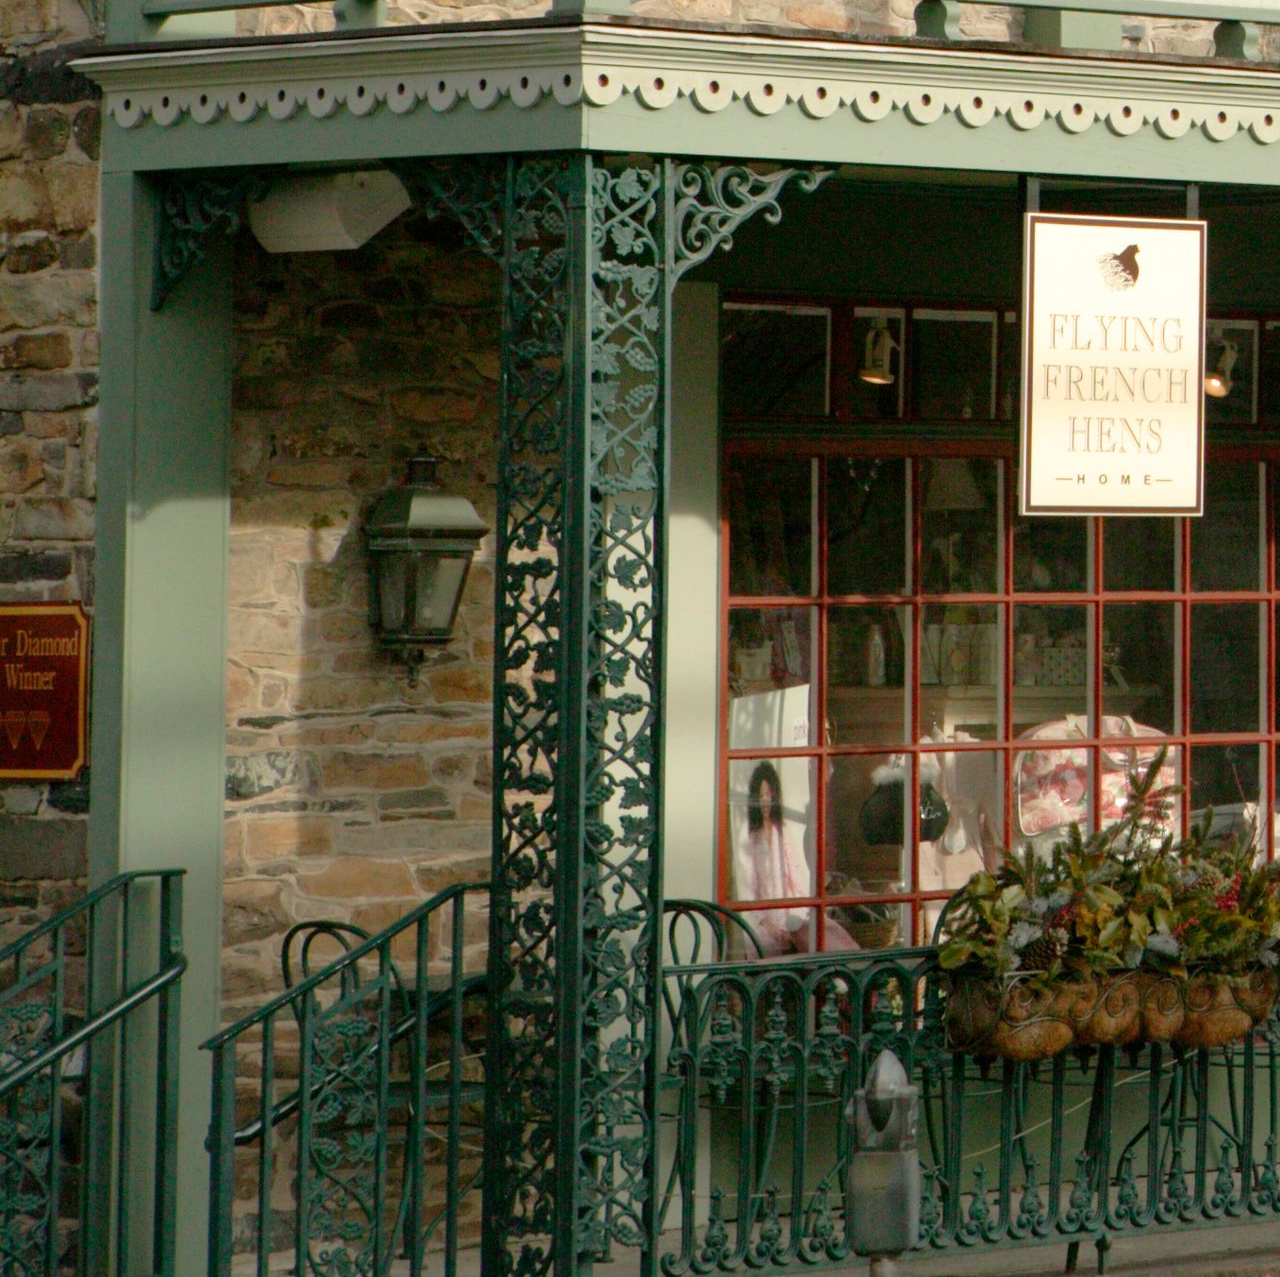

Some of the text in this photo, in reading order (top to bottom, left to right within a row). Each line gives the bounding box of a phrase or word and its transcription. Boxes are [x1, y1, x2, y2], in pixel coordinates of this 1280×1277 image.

[1048, 313, 1184, 354] FLYING
[1041, 364, 1189, 404] FRENCH
[1066, 415, 1163, 454] HENS
[1076, 474, 1152, 486] HOME
[15, 629, 79, 657] Diamond
[4, 663, 57, 690] Winner
